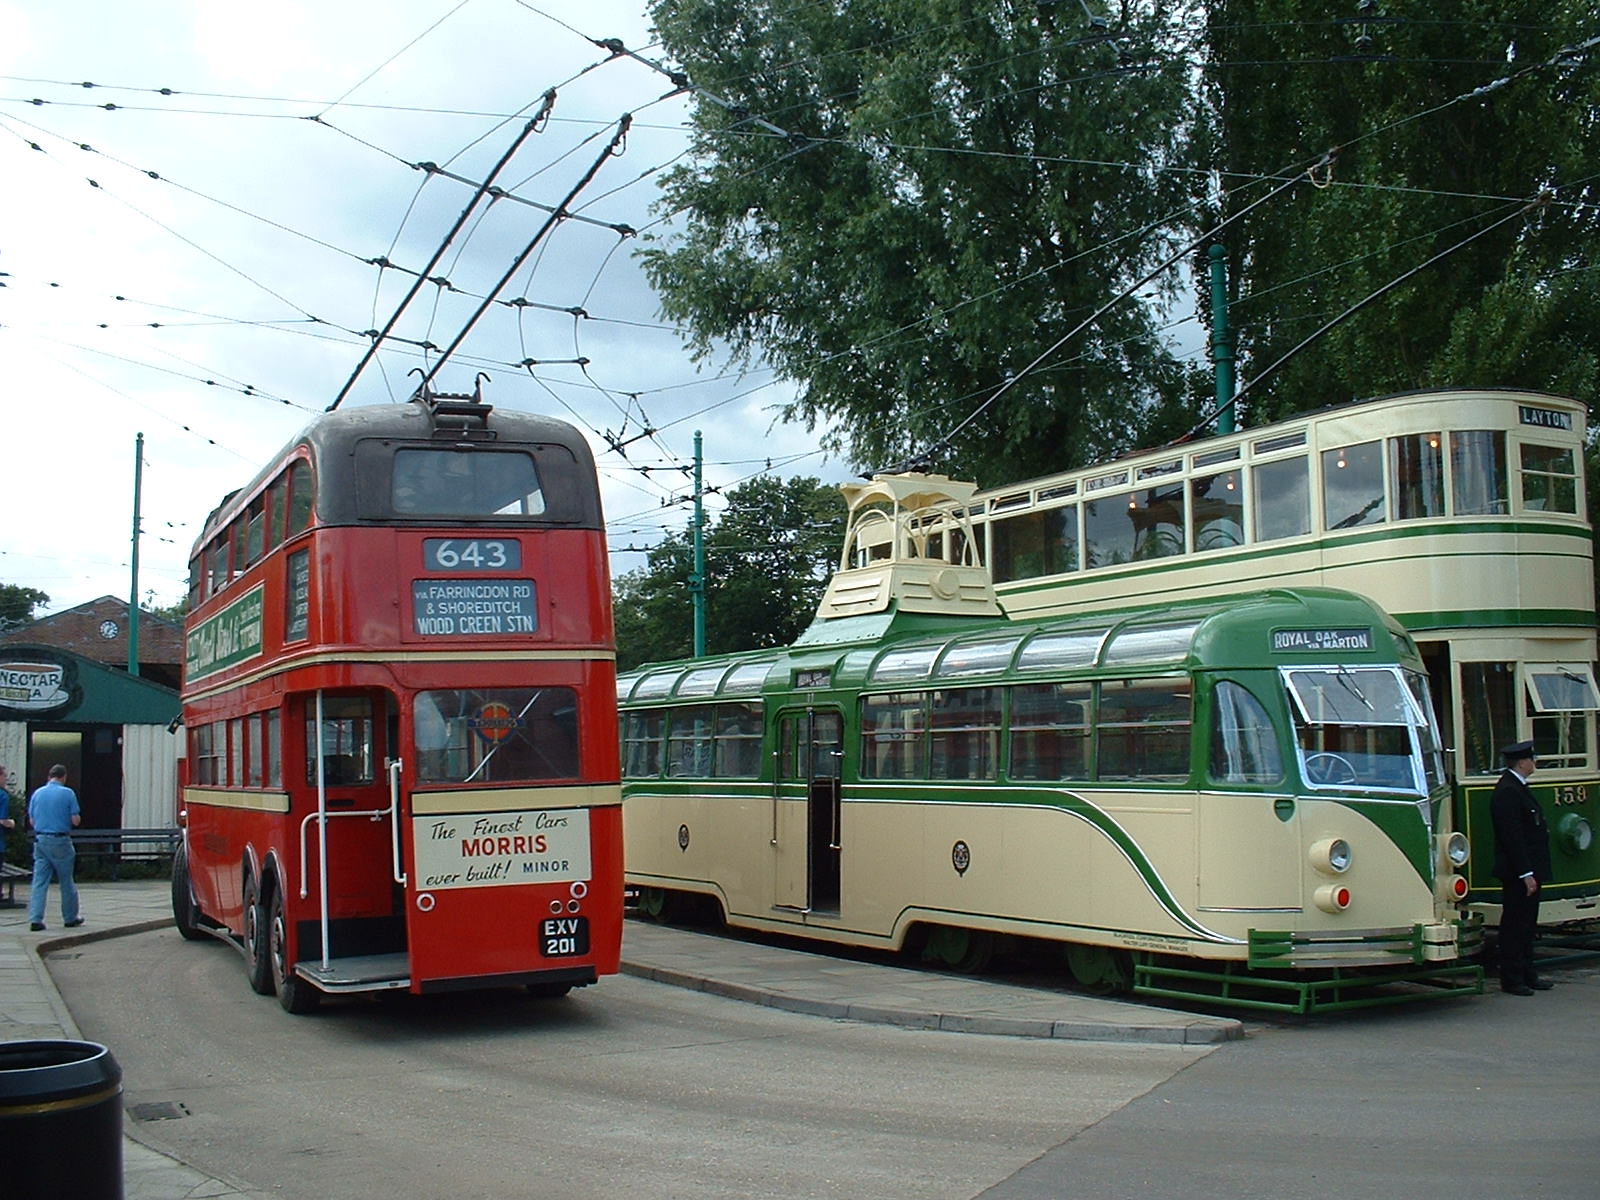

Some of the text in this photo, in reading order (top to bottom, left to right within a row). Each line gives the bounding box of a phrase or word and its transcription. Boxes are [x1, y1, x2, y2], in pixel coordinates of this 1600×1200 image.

[1523, 408, 1568, 428] LAYTON
[436, 540, 507, 568] 643
[429, 586, 509, 599] FARRINGDON
[513, 585, 531, 598] RD
[426, 601, 521, 615] & SHOREDITCH
[417, 615, 533, 635] WOOD GREEN STN
[1273, 631, 1339, 649] ROYAL OAK
[1322, 633, 1369, 649] MARTON
[0, 671, 60, 687] NECTAR
[1553, 785, 1587, 806] 159
[431, 812, 569, 840] The Finest Cars
[461, 834, 548, 857] MORRIS
[426, 860, 513, 886] ever built!
[523, 860, 570, 873] MINOR
[544, 919, 579, 936] EXV
[547, 938, 576, 954] 201
